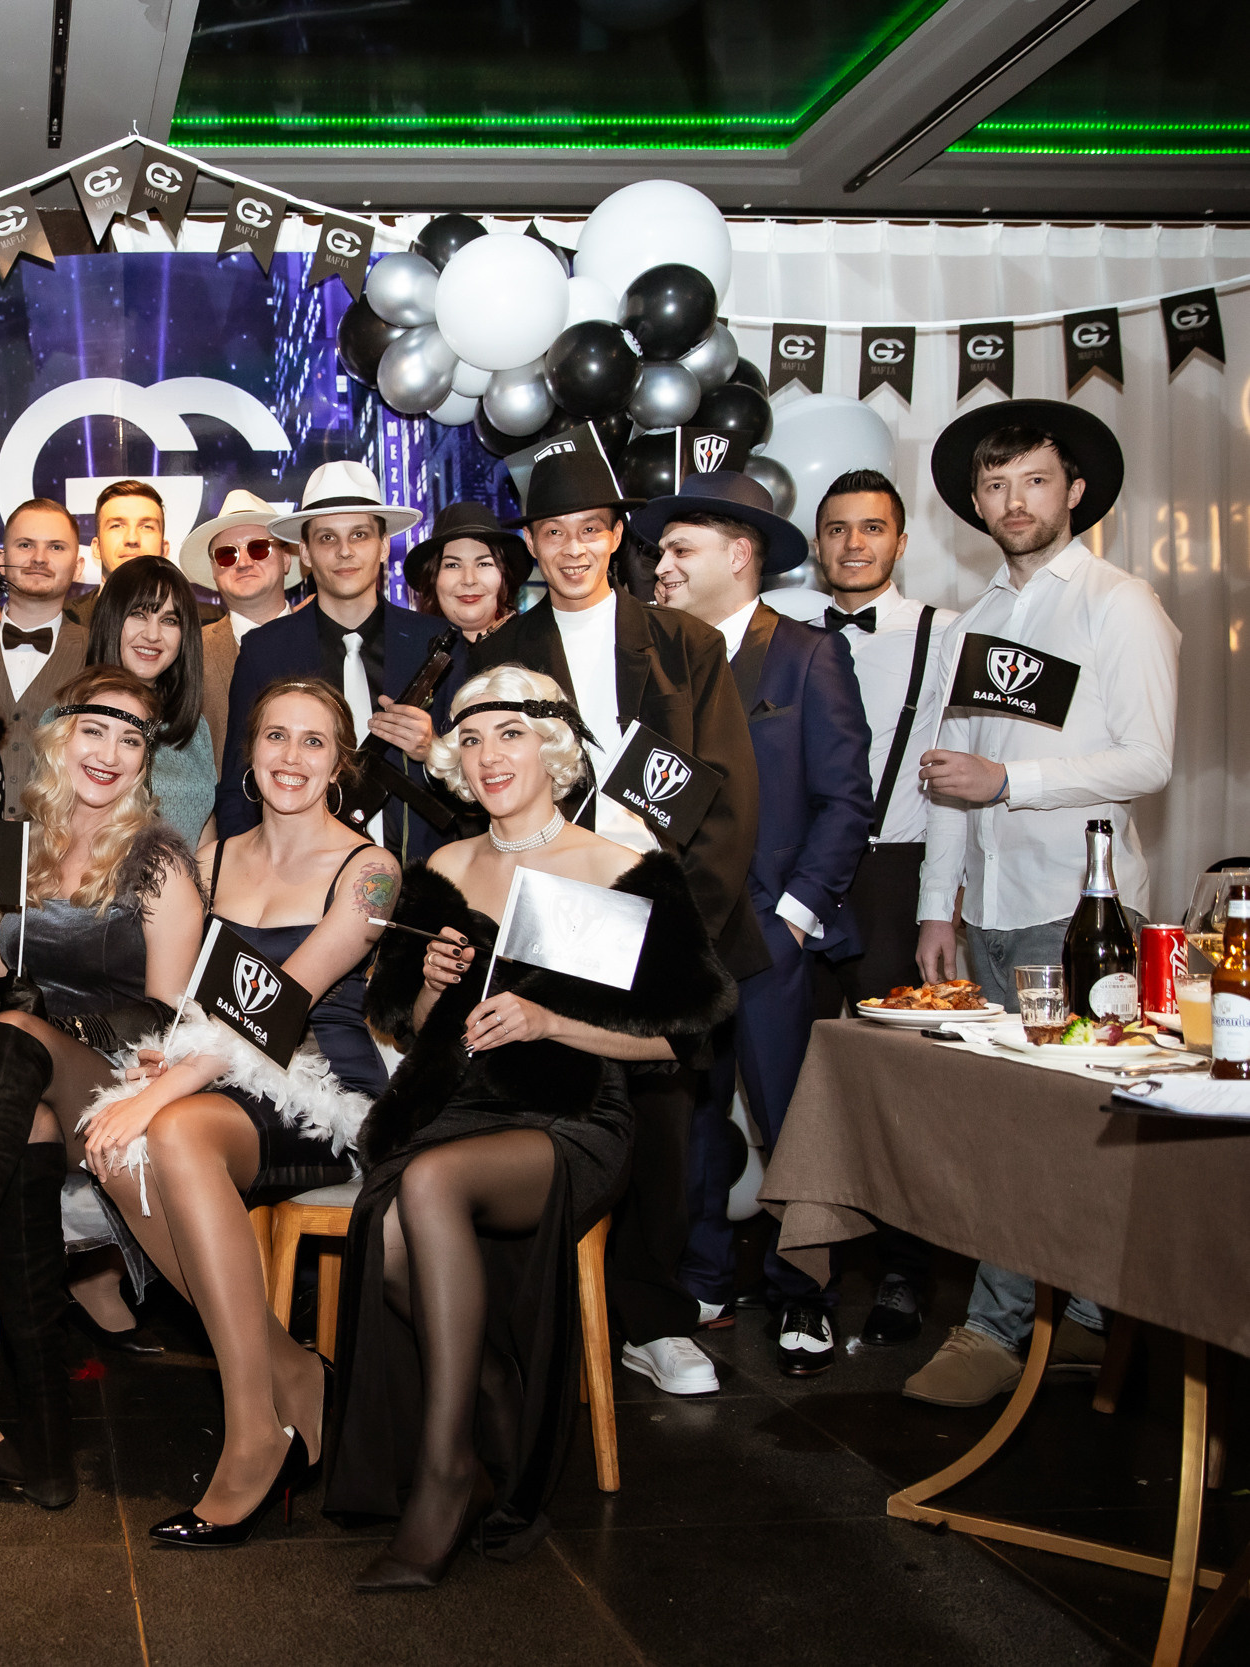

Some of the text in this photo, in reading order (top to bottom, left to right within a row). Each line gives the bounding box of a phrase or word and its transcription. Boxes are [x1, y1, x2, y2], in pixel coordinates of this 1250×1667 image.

[95, 194, 121, 211] MAFIA
[144, 187, 168, 204] MAFIA
[234, 223, 259, 240] MAFIA
[0, 233, 27, 249] MAFIA
[325, 253, 350, 269] MAFIA
[973, 690, 1037, 712] BABA-YAGA
[622, 788, 671, 826] BABA-YAGA
[216, 997, 268, 1042] BABA-YAGA
